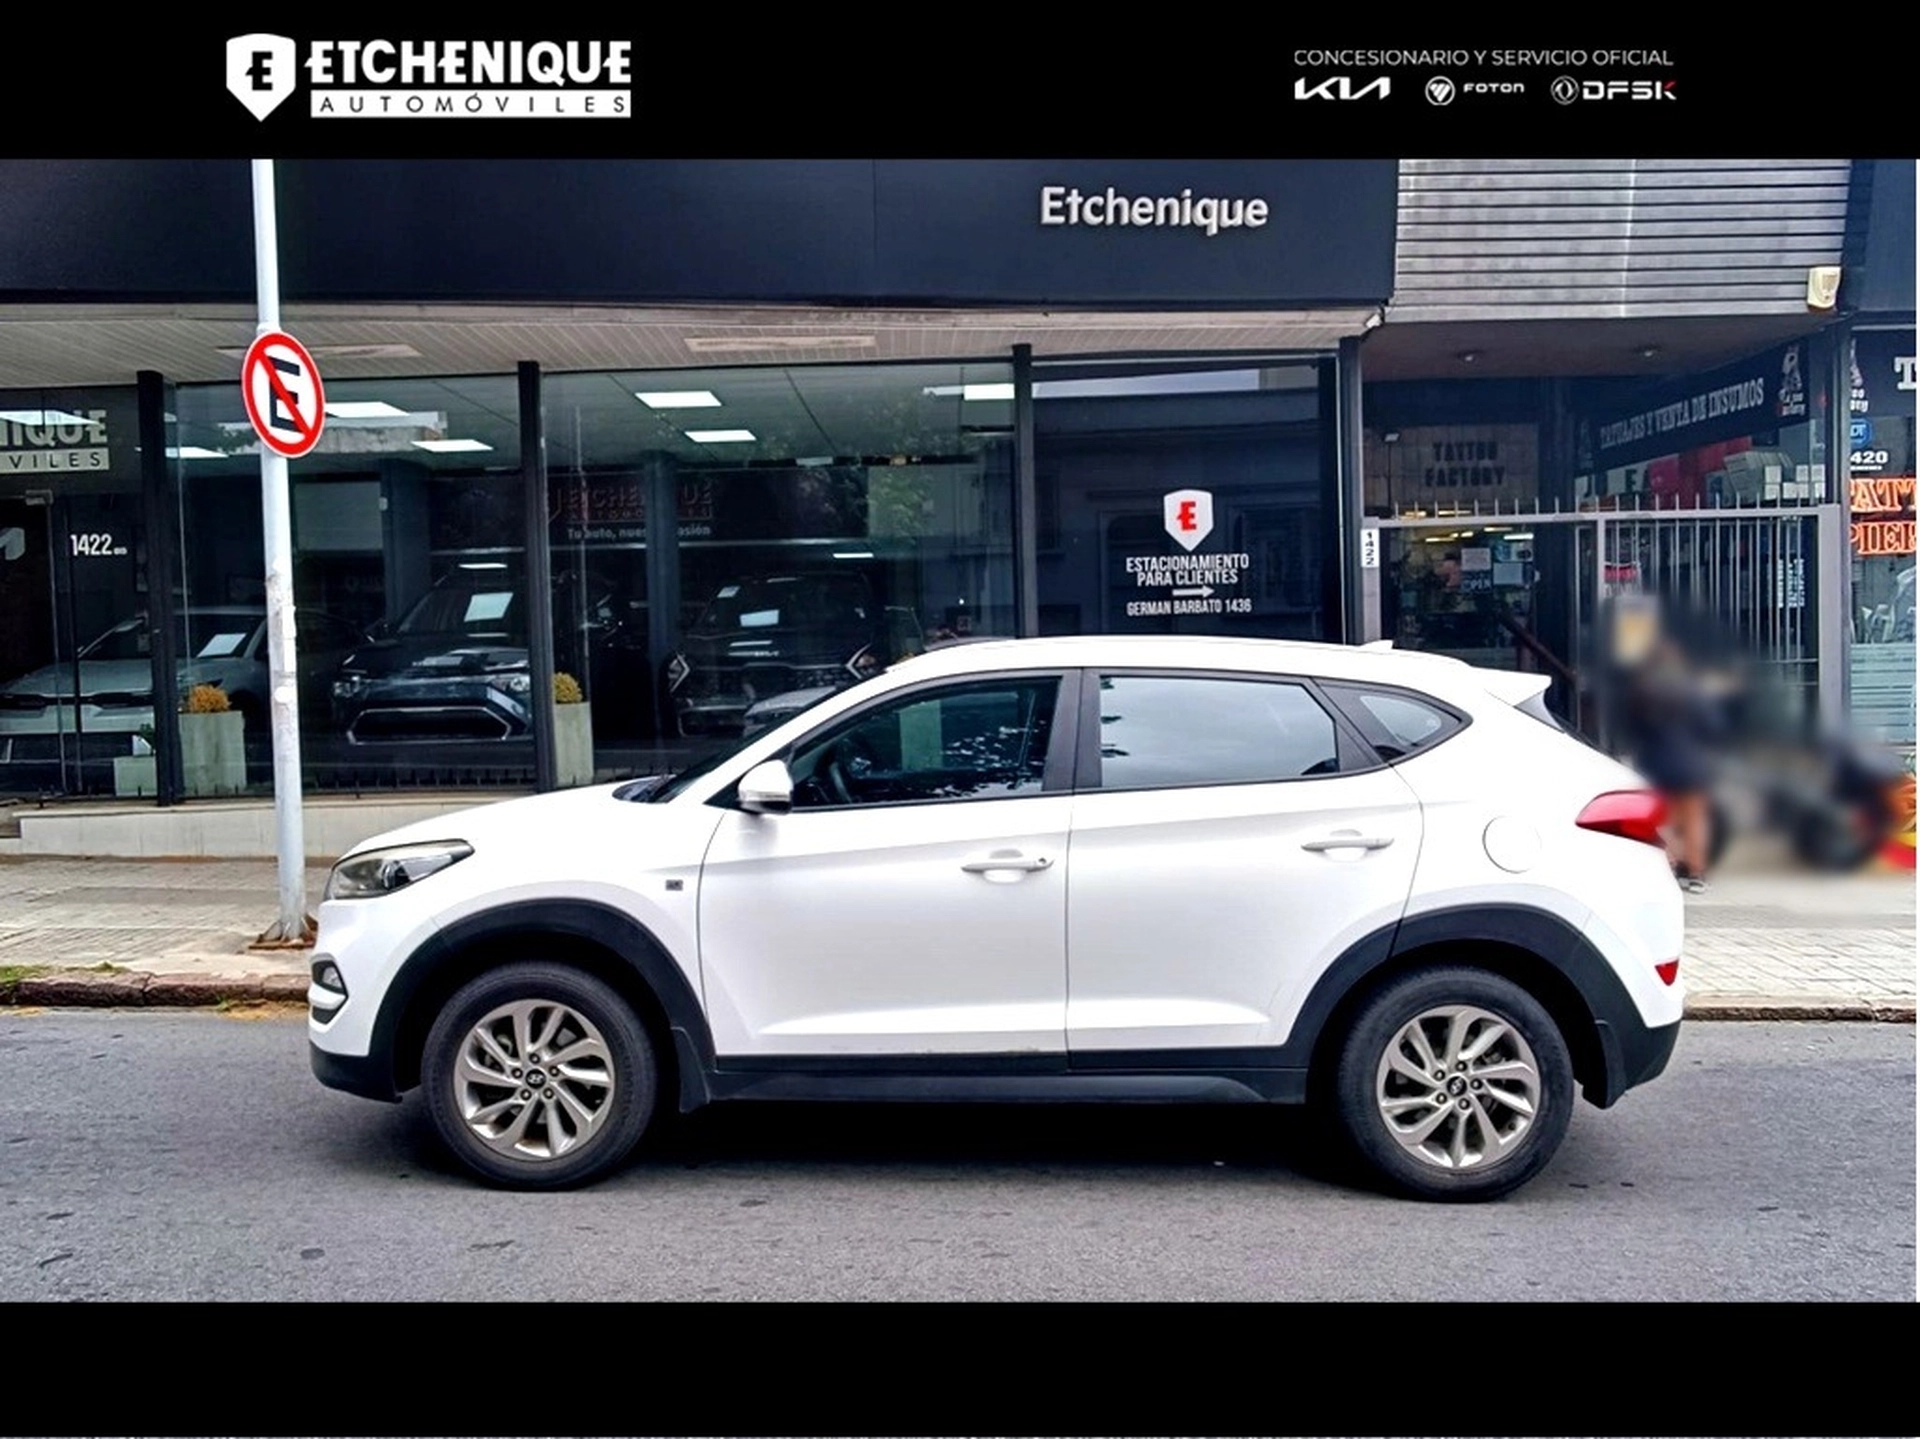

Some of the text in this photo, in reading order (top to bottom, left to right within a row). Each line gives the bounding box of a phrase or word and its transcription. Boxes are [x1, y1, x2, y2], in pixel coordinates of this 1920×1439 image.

[1041, 186, 1269, 237] Etchenique
[9, 452, 101, 469] VILES
[1850, 478, 1917, 512] AT
[70, 533, 113, 556] 1422
[1365, 531, 1374, 566] 1422
[1126, 553, 1249, 573] ESTACIONAMIENTO
[1137, 568, 1238, 587] PARA CLIENTES
[1126, 601, 1172, 616] GERMAN
[1173, 598, 1223, 614] BARBATO
